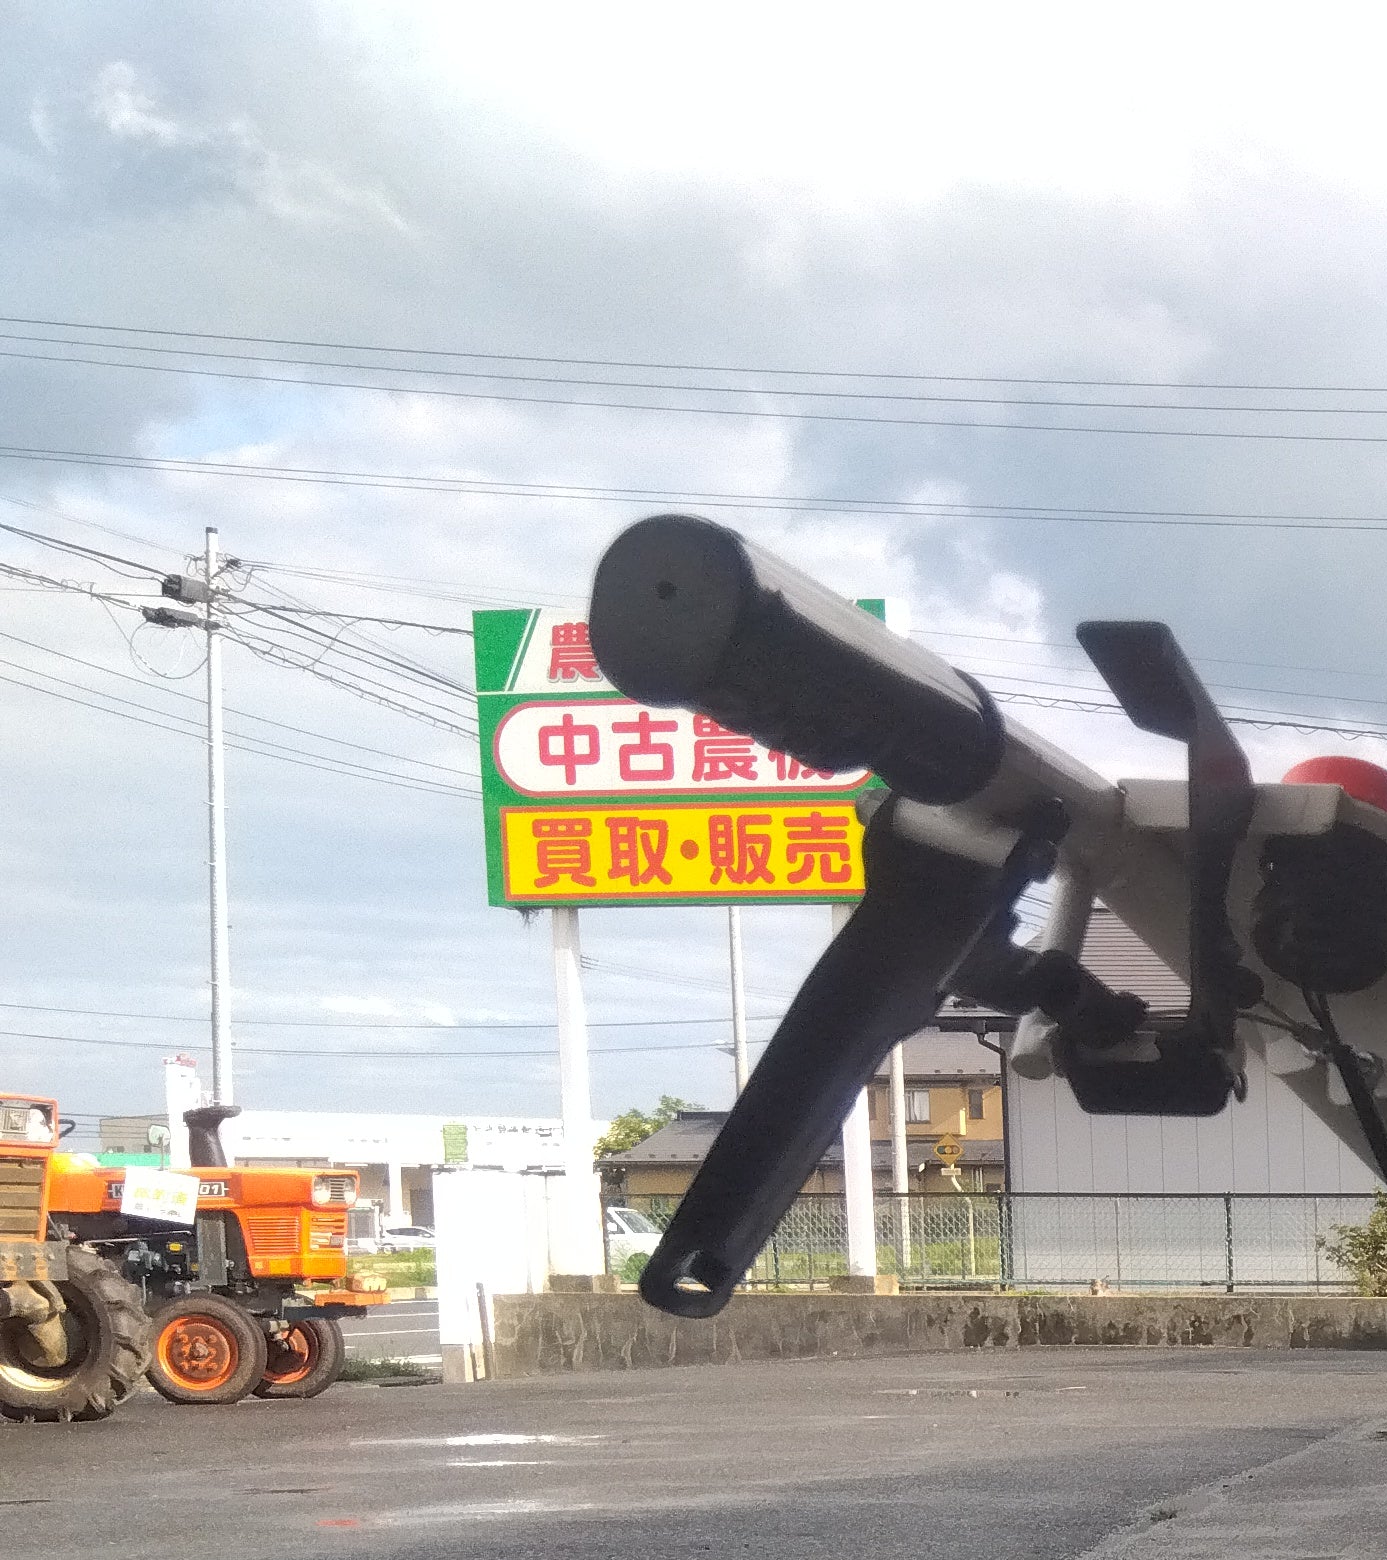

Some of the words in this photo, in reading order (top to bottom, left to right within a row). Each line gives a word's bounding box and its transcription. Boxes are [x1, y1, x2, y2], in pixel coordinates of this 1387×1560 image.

[532, 811, 853, 888] 買取・販売
